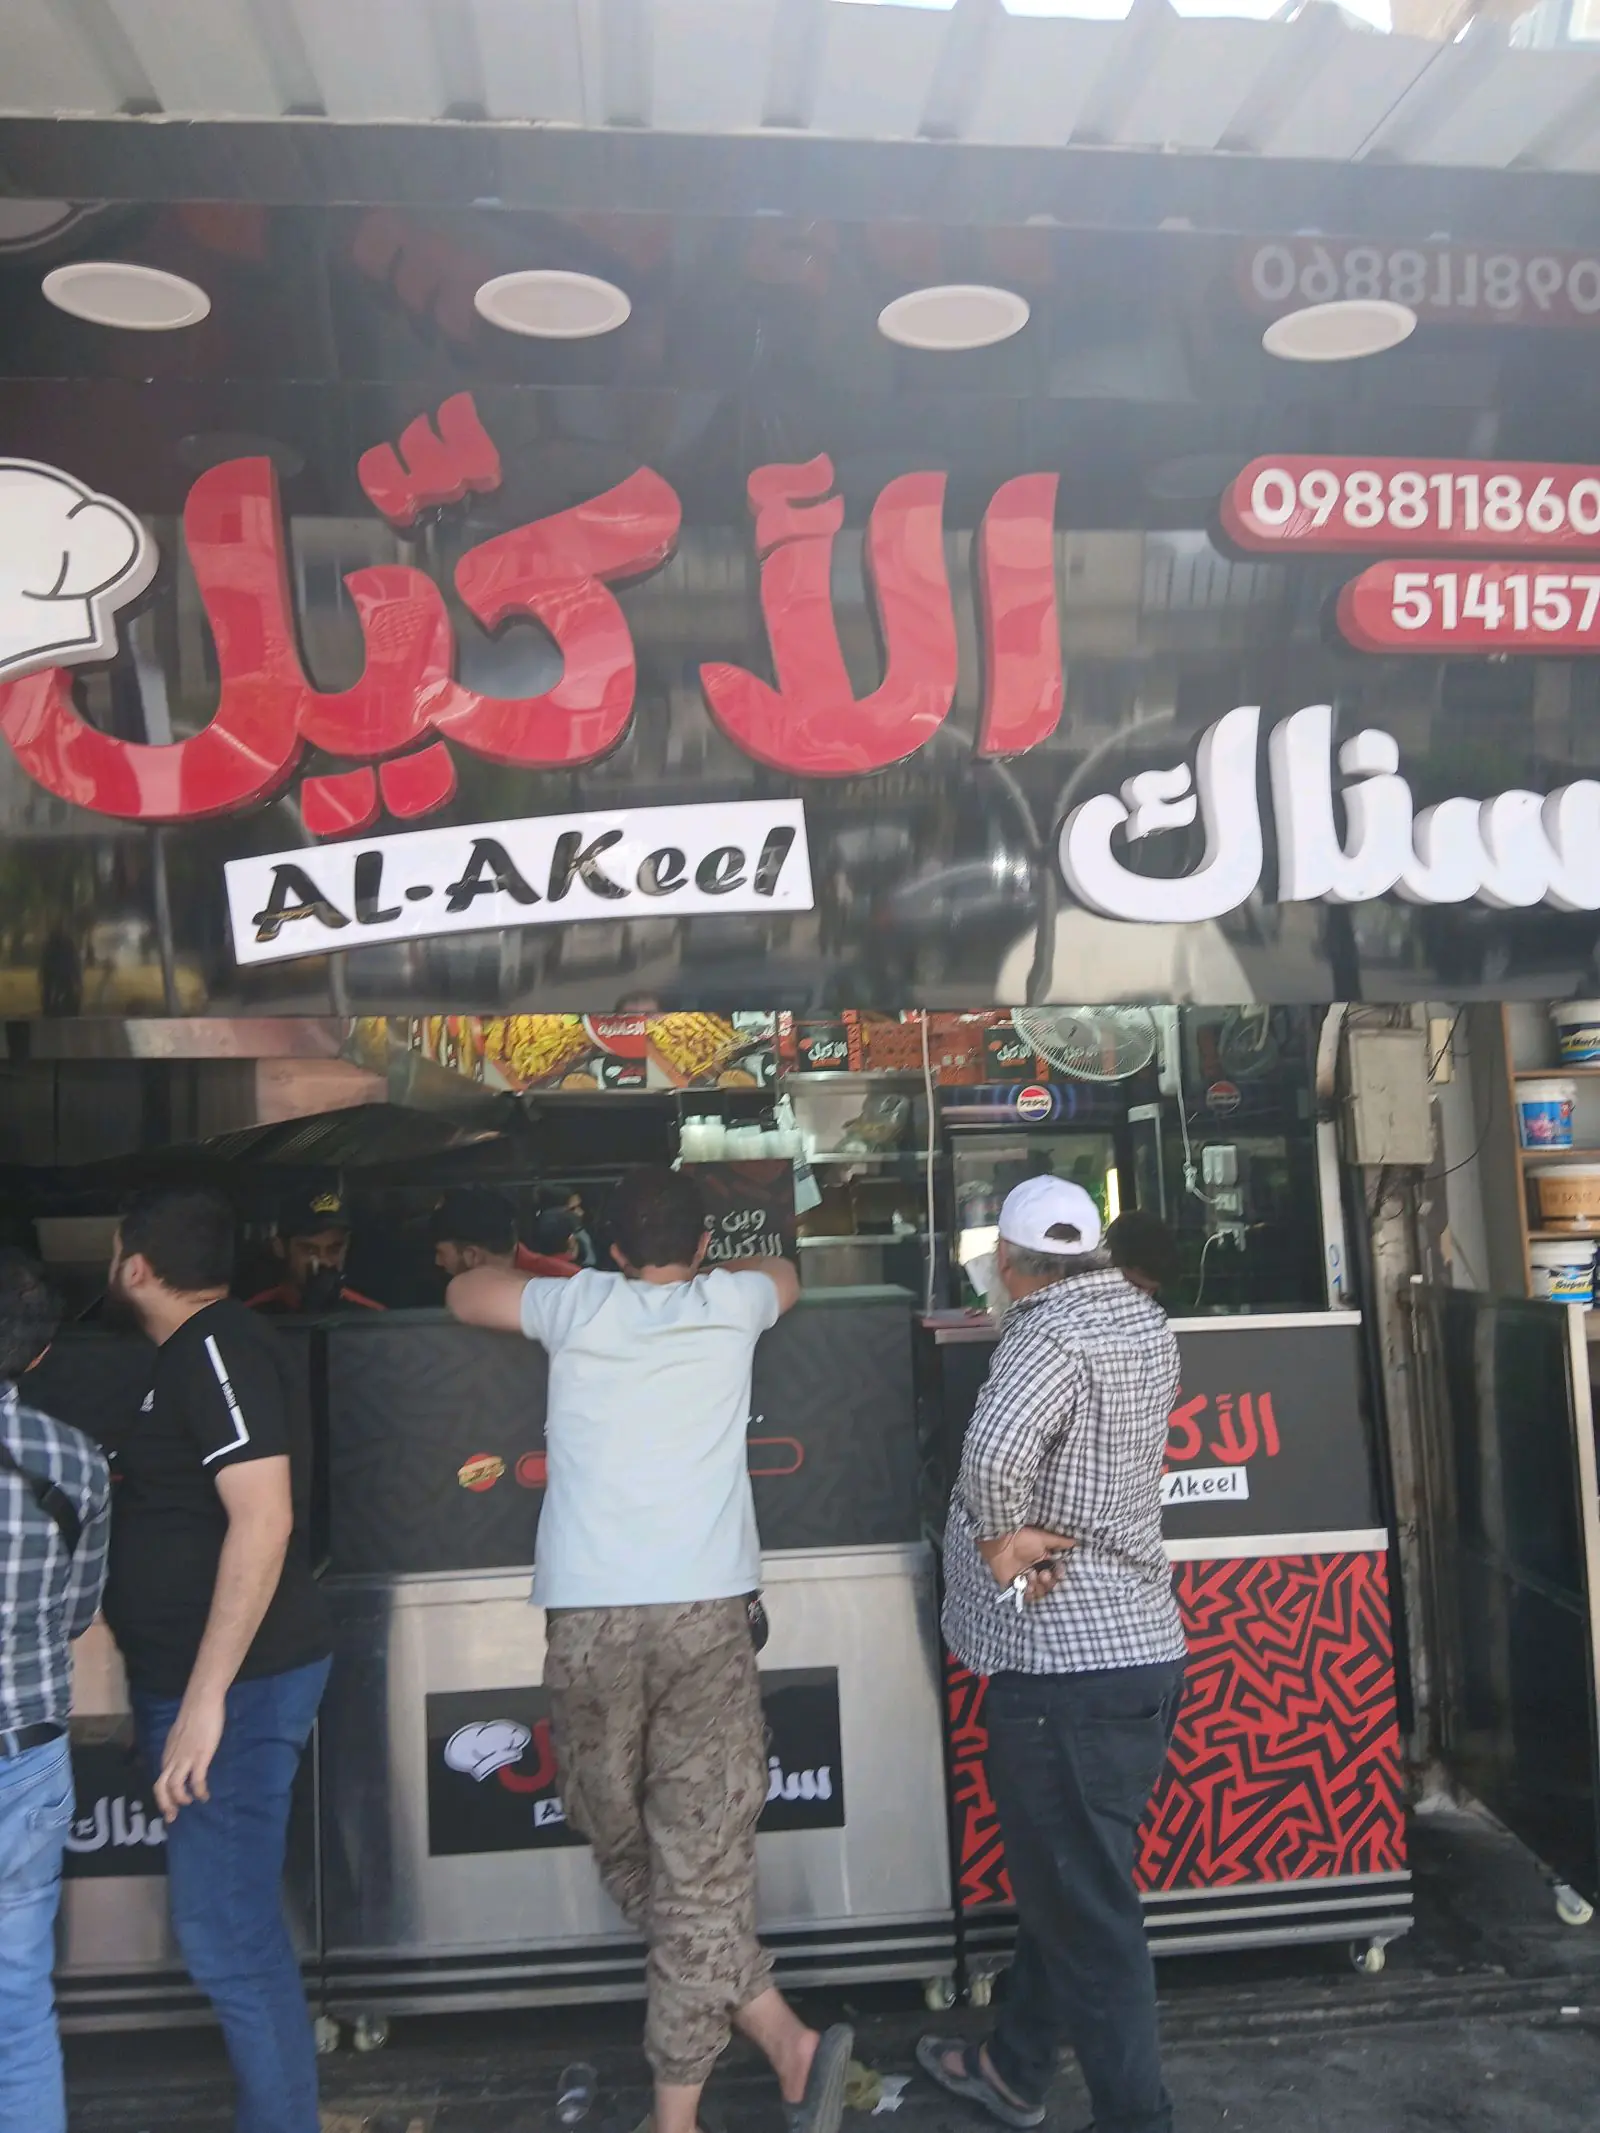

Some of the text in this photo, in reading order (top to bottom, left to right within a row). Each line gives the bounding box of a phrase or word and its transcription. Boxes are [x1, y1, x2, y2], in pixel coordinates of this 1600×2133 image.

[1250, 468, 1600, 535] 098811860
[1390, 571, 1600, 632] 514157
[721, 1209, 767, 1233] وين
[1163, 1386, 1280, 1465] الأك
